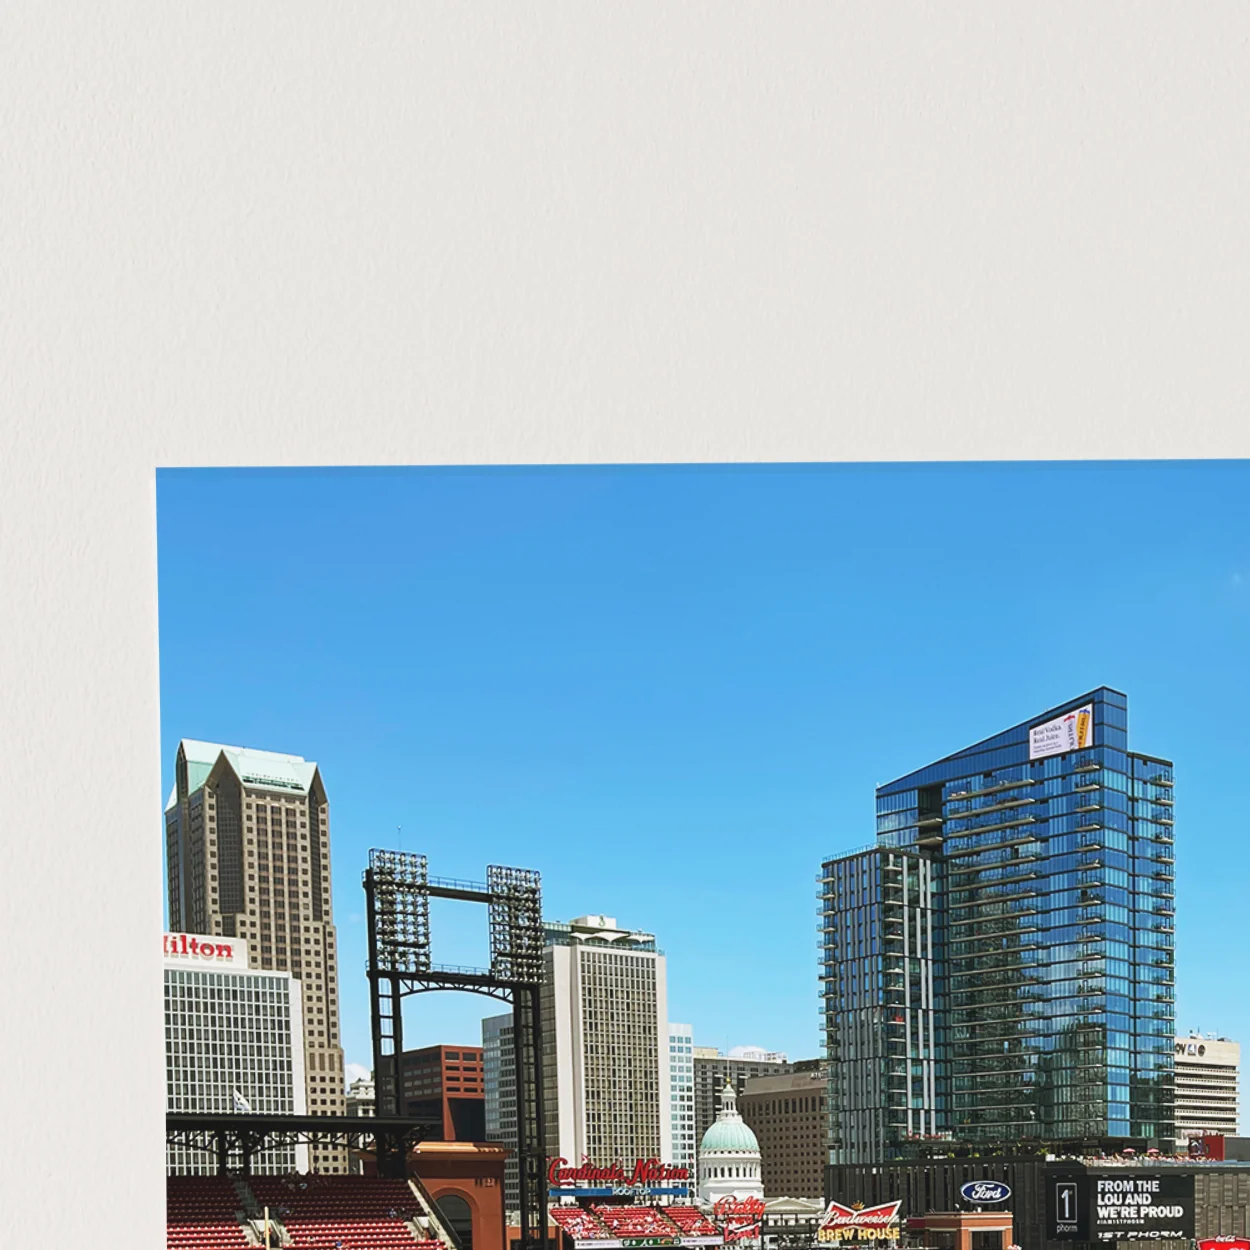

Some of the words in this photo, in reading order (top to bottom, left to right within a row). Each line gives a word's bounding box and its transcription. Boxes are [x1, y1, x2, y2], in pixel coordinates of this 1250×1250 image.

[549, 1157, 625, 1186] Cardinals
[626, 1158, 689, 1186] Nation
[612, 1187, 651, 1196] ROOFTOP
[971, 1184, 1001, 1199] Ford
[1098, 1181, 1134, 1192] FROM
[1137, 1181, 1160, 1192] THE
[1098, 1193, 1124, 1205] LOU
[1125, 1193, 1152, 1205] AND
[1097, 1206, 1138, 1218] WE'RE
[1140, 1206, 1183, 1218] PROUD
[821, 1210, 897, 1229] Budweiser
[818, 1227, 853, 1241] BREW
[857, 1227, 900, 1240] HOUSE
[1057, 1224, 1078, 1233] phorm
